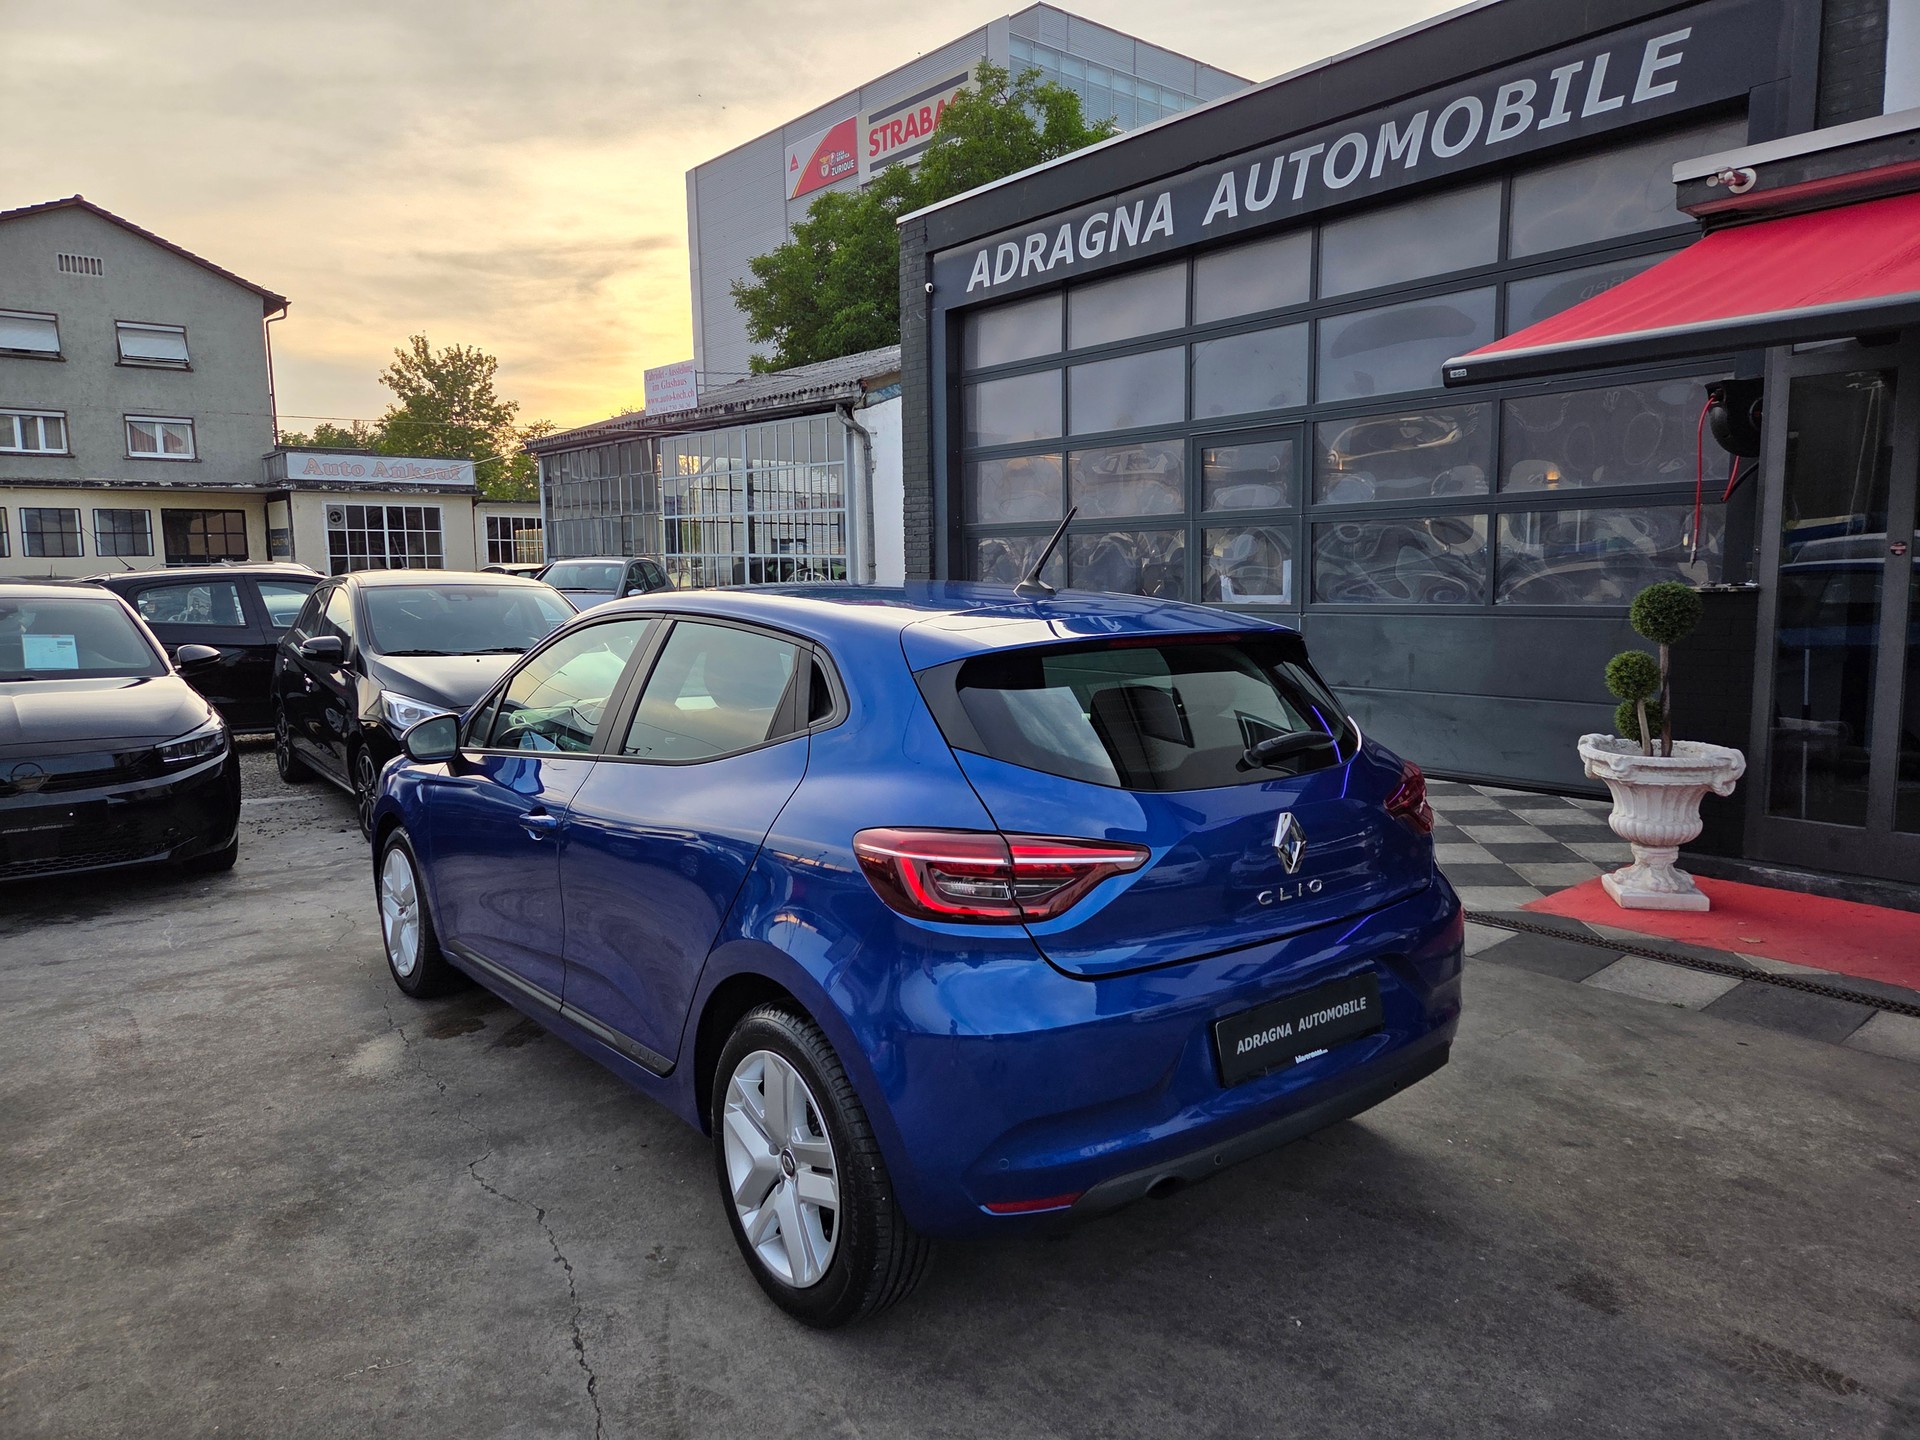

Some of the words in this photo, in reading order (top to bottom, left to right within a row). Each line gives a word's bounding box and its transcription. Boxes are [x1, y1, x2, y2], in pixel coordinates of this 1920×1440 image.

[869, 91, 959, 157] STRABA
[966, 192, 1174, 293] ADRAGNA
[1202, 27, 1692, 226] AUTOMOBILE
[661, 378, 688, 390] Glashaus
[302, 457, 366, 477] Auto
[370, 460, 463, 481] Ankauf
[1257, 879, 1323, 906] CLIO
[1236, 1022, 1293, 1055] ADRAGNA
[1298, 996, 1367, 1032] AUTOMOBILE
